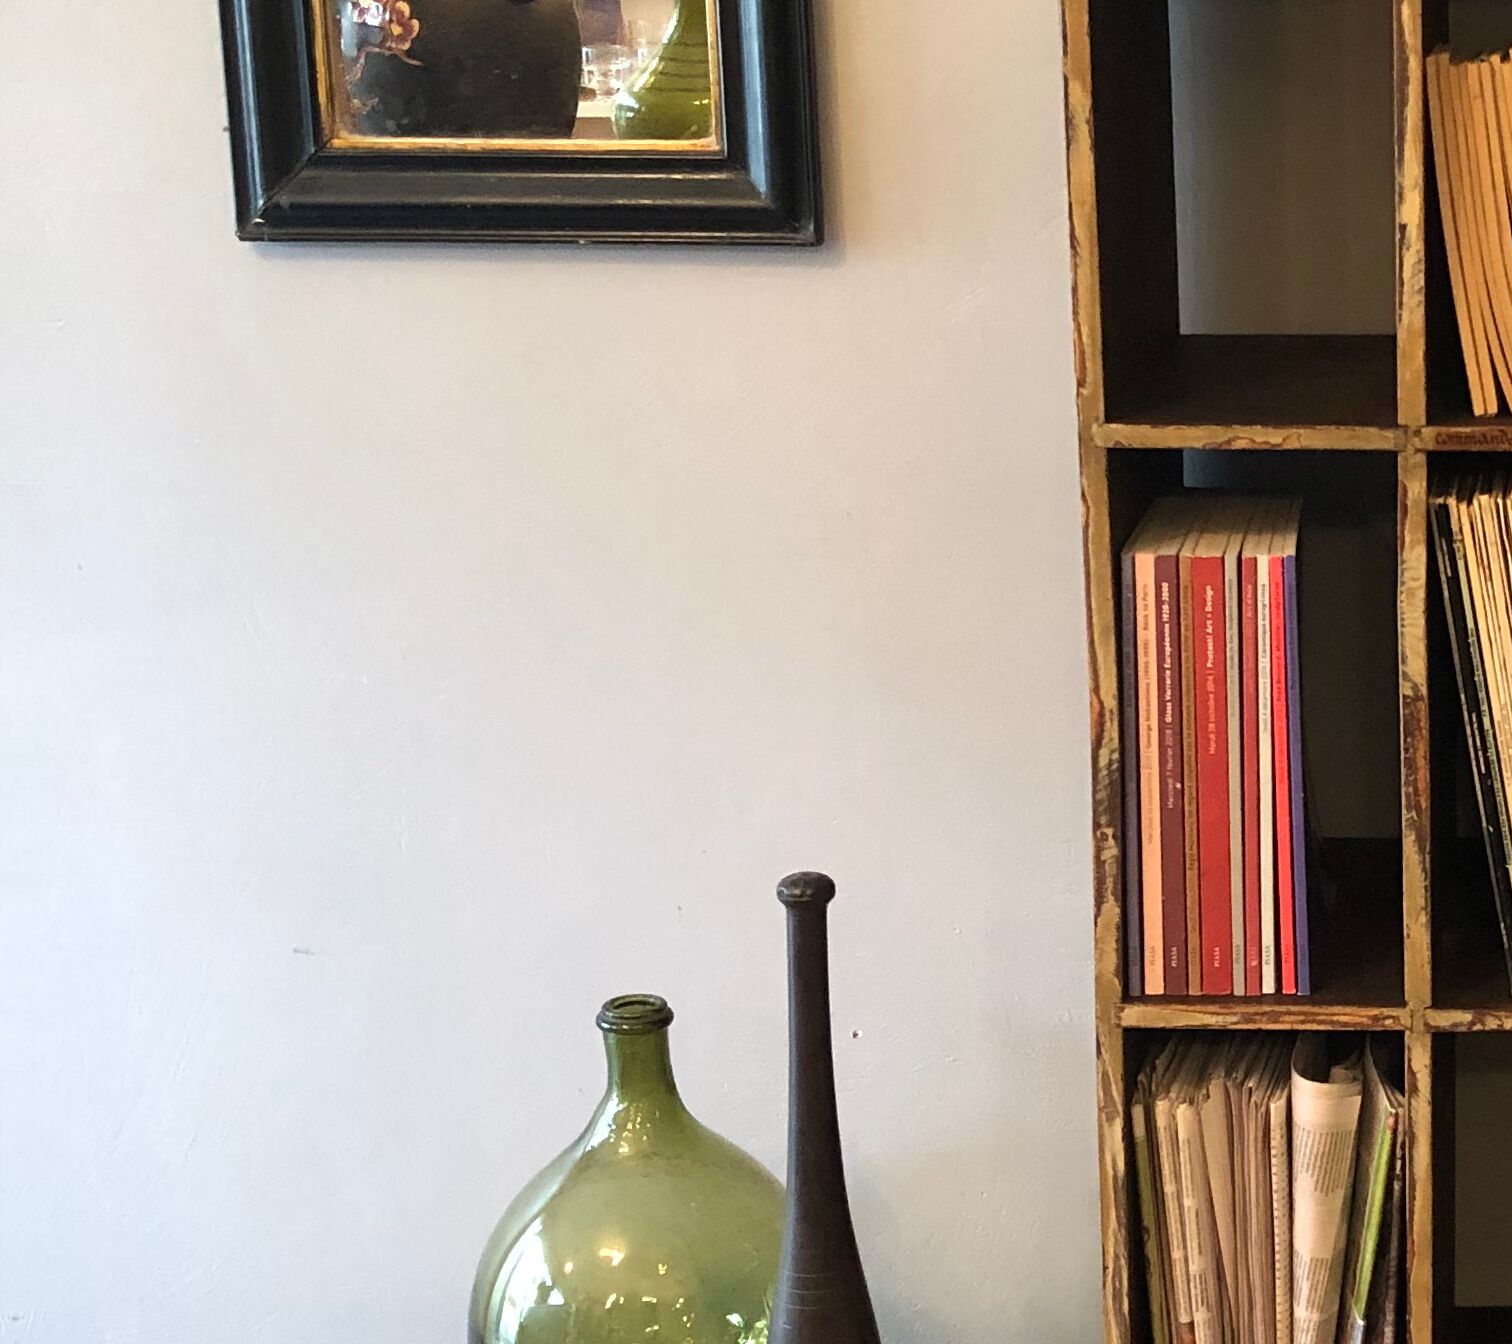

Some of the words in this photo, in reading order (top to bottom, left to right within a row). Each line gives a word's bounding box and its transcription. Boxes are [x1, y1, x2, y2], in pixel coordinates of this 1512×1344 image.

[1204, 585, 1214, 612] Design
[1205, 620, 1213, 633] Art
[1162, 623, 1172, 668] Européenne
[1163, 669, 1172, 700] Verrerie
[1164, 702, 1172, 723] Glass
